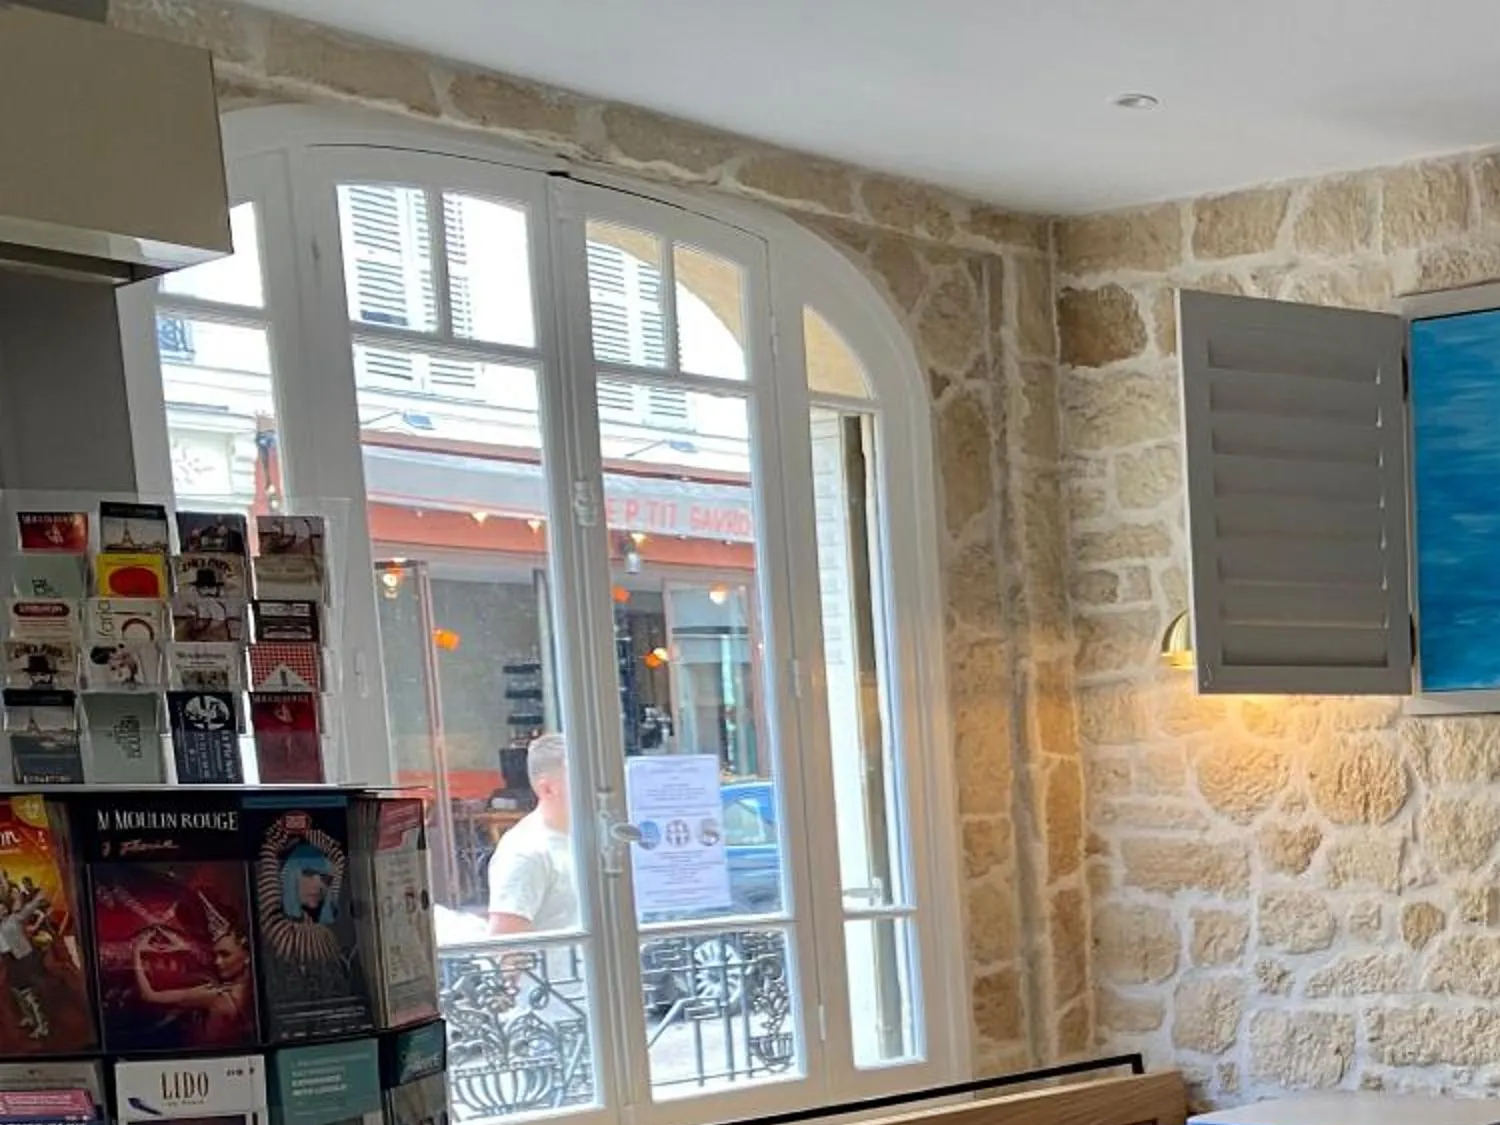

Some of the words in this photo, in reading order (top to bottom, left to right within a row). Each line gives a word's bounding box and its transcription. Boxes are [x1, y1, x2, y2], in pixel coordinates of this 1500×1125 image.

[115, 809, 177, 831] MOULIN
[181, 811, 239, 831] ROUGE
[160, 1071, 209, 1101] LIDO
